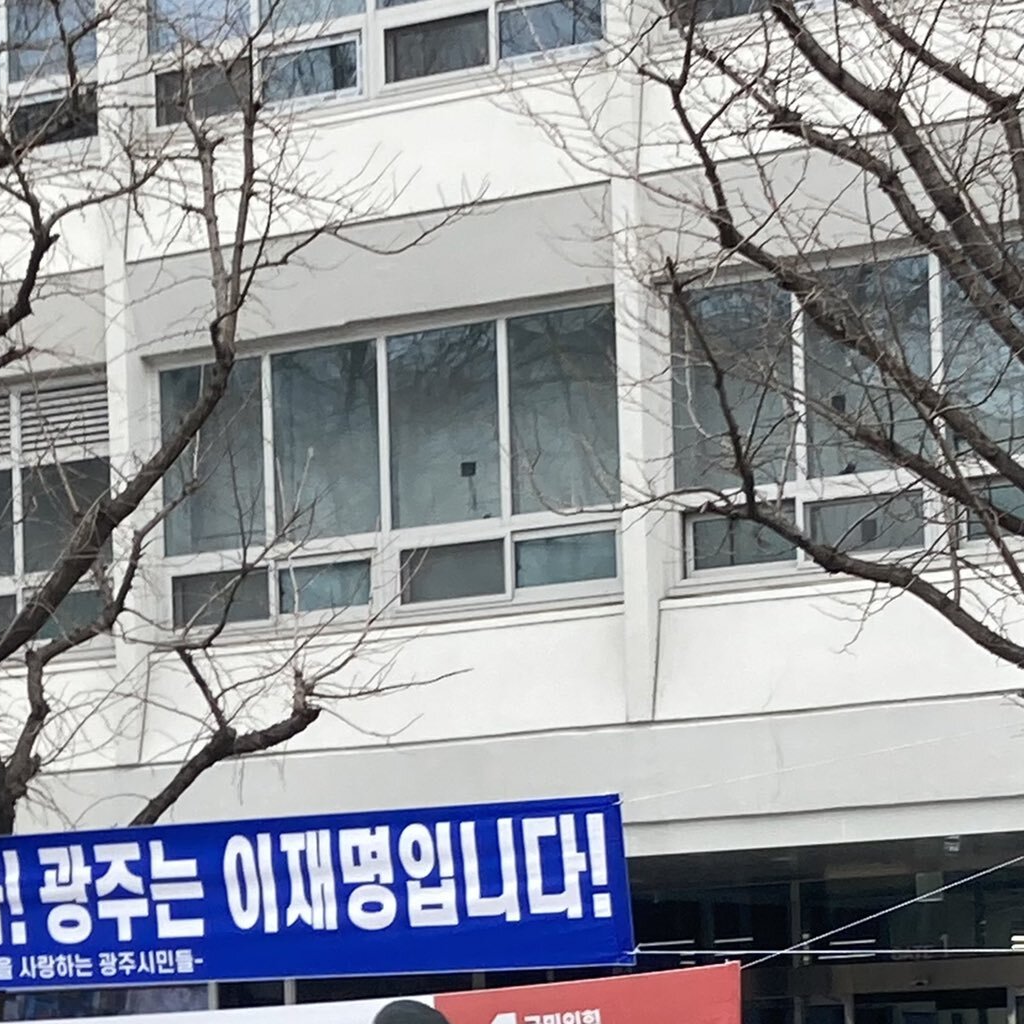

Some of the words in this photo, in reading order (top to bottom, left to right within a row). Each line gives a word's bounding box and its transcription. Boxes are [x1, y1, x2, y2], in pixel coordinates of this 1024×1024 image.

[38, 840, 205, 943] 광주는
[223, 814, 612, 932] 이재명입니다!
[20, 955, 92, 978] 사랑하는
[100, 950, 202, 975] 광주시민들-
